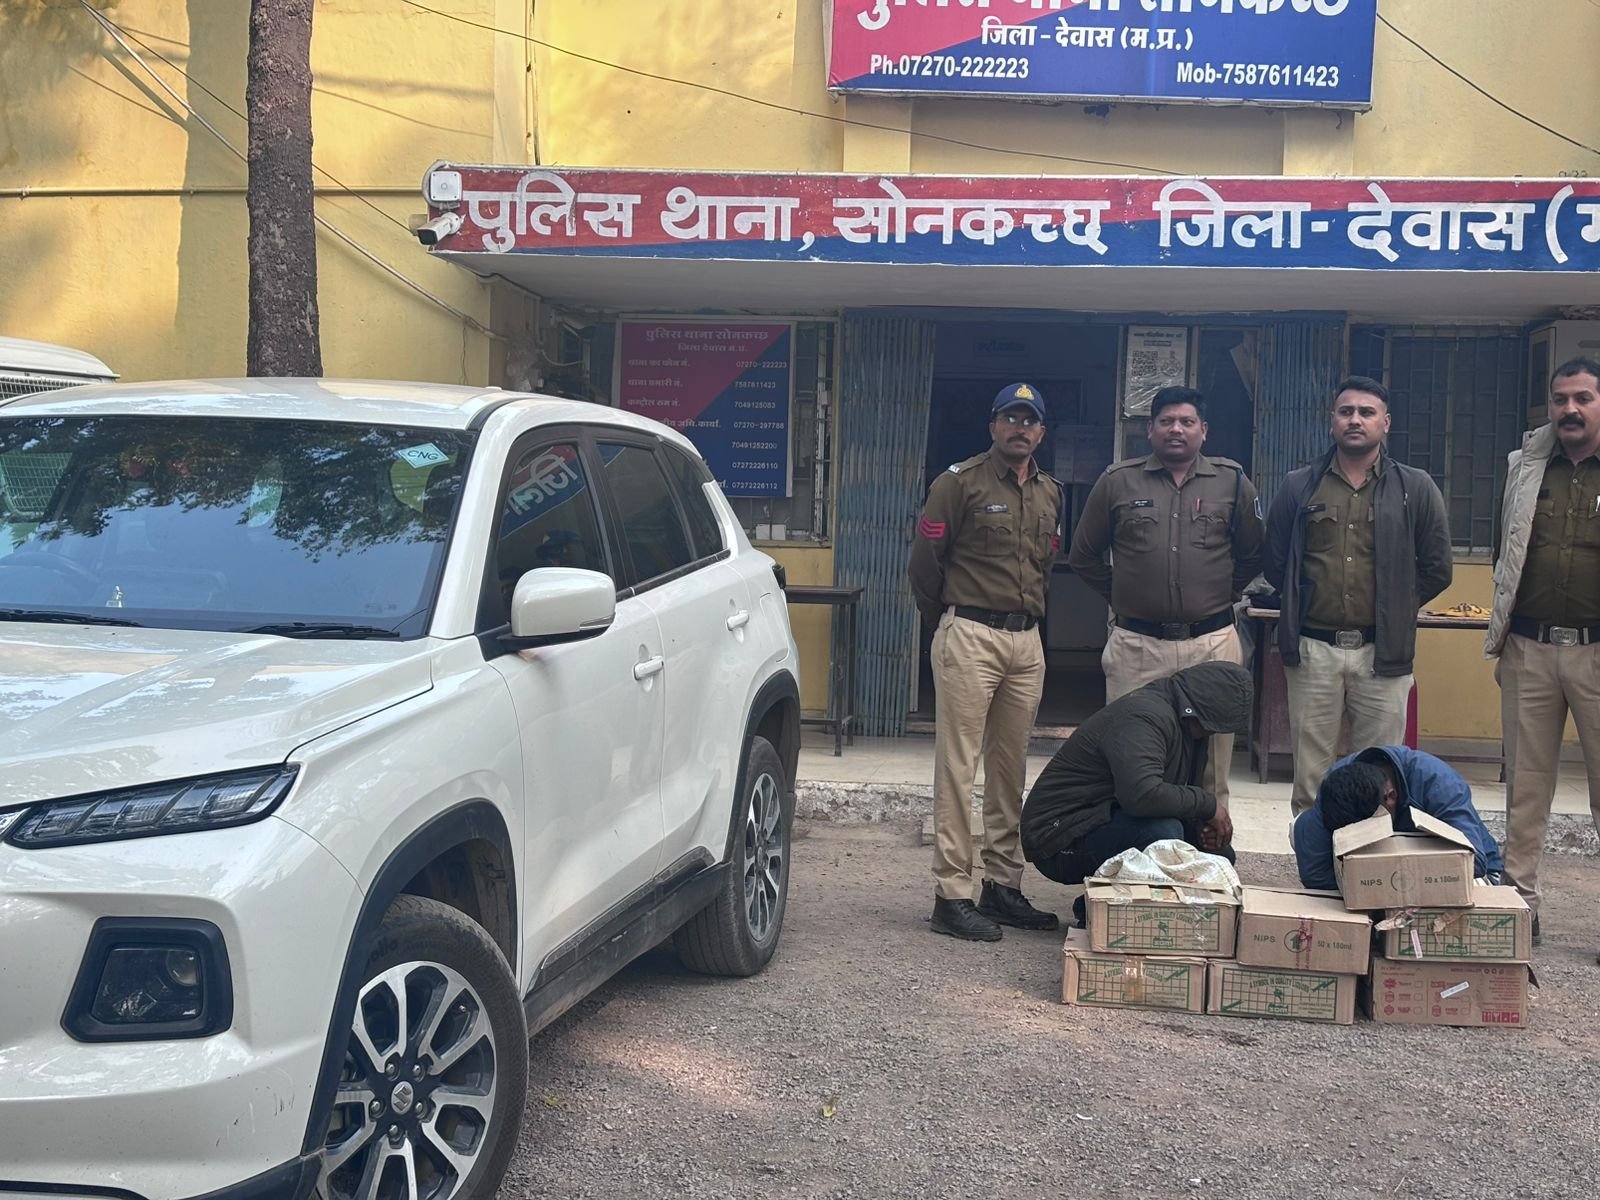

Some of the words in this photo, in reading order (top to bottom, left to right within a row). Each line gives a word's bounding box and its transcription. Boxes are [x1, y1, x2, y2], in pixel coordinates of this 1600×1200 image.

[981, 16, 1037, 47] जिला
[1055, 17, 1115, 49] देवास
[1121, 22, 1194, 52] (म.प्र.)
[869, 54, 1030, 79] Ph.07270-222223
[1177, 63, 1340, 88] Mob-7587611423
[462, 171, 642, 253] पुलिस
[660, 186, 816, 252] थाना,
[832, 178, 1111, 255] सोनकच्छ
[1346, 182, 1536, 263] देवास
[646, 327, 682, 342] पुलिस
[684, 330, 713, 341] थाना
[735, 360, 788, 369] 07270-222223
[407, 449, 440, 461] CNG
[1359, 878, 1384, 887] NIPS
[1424, 876, 1433, 884] 50
[1253, 934, 1277, 943] NIPS
[1317, 940, 1325, 948] 50
